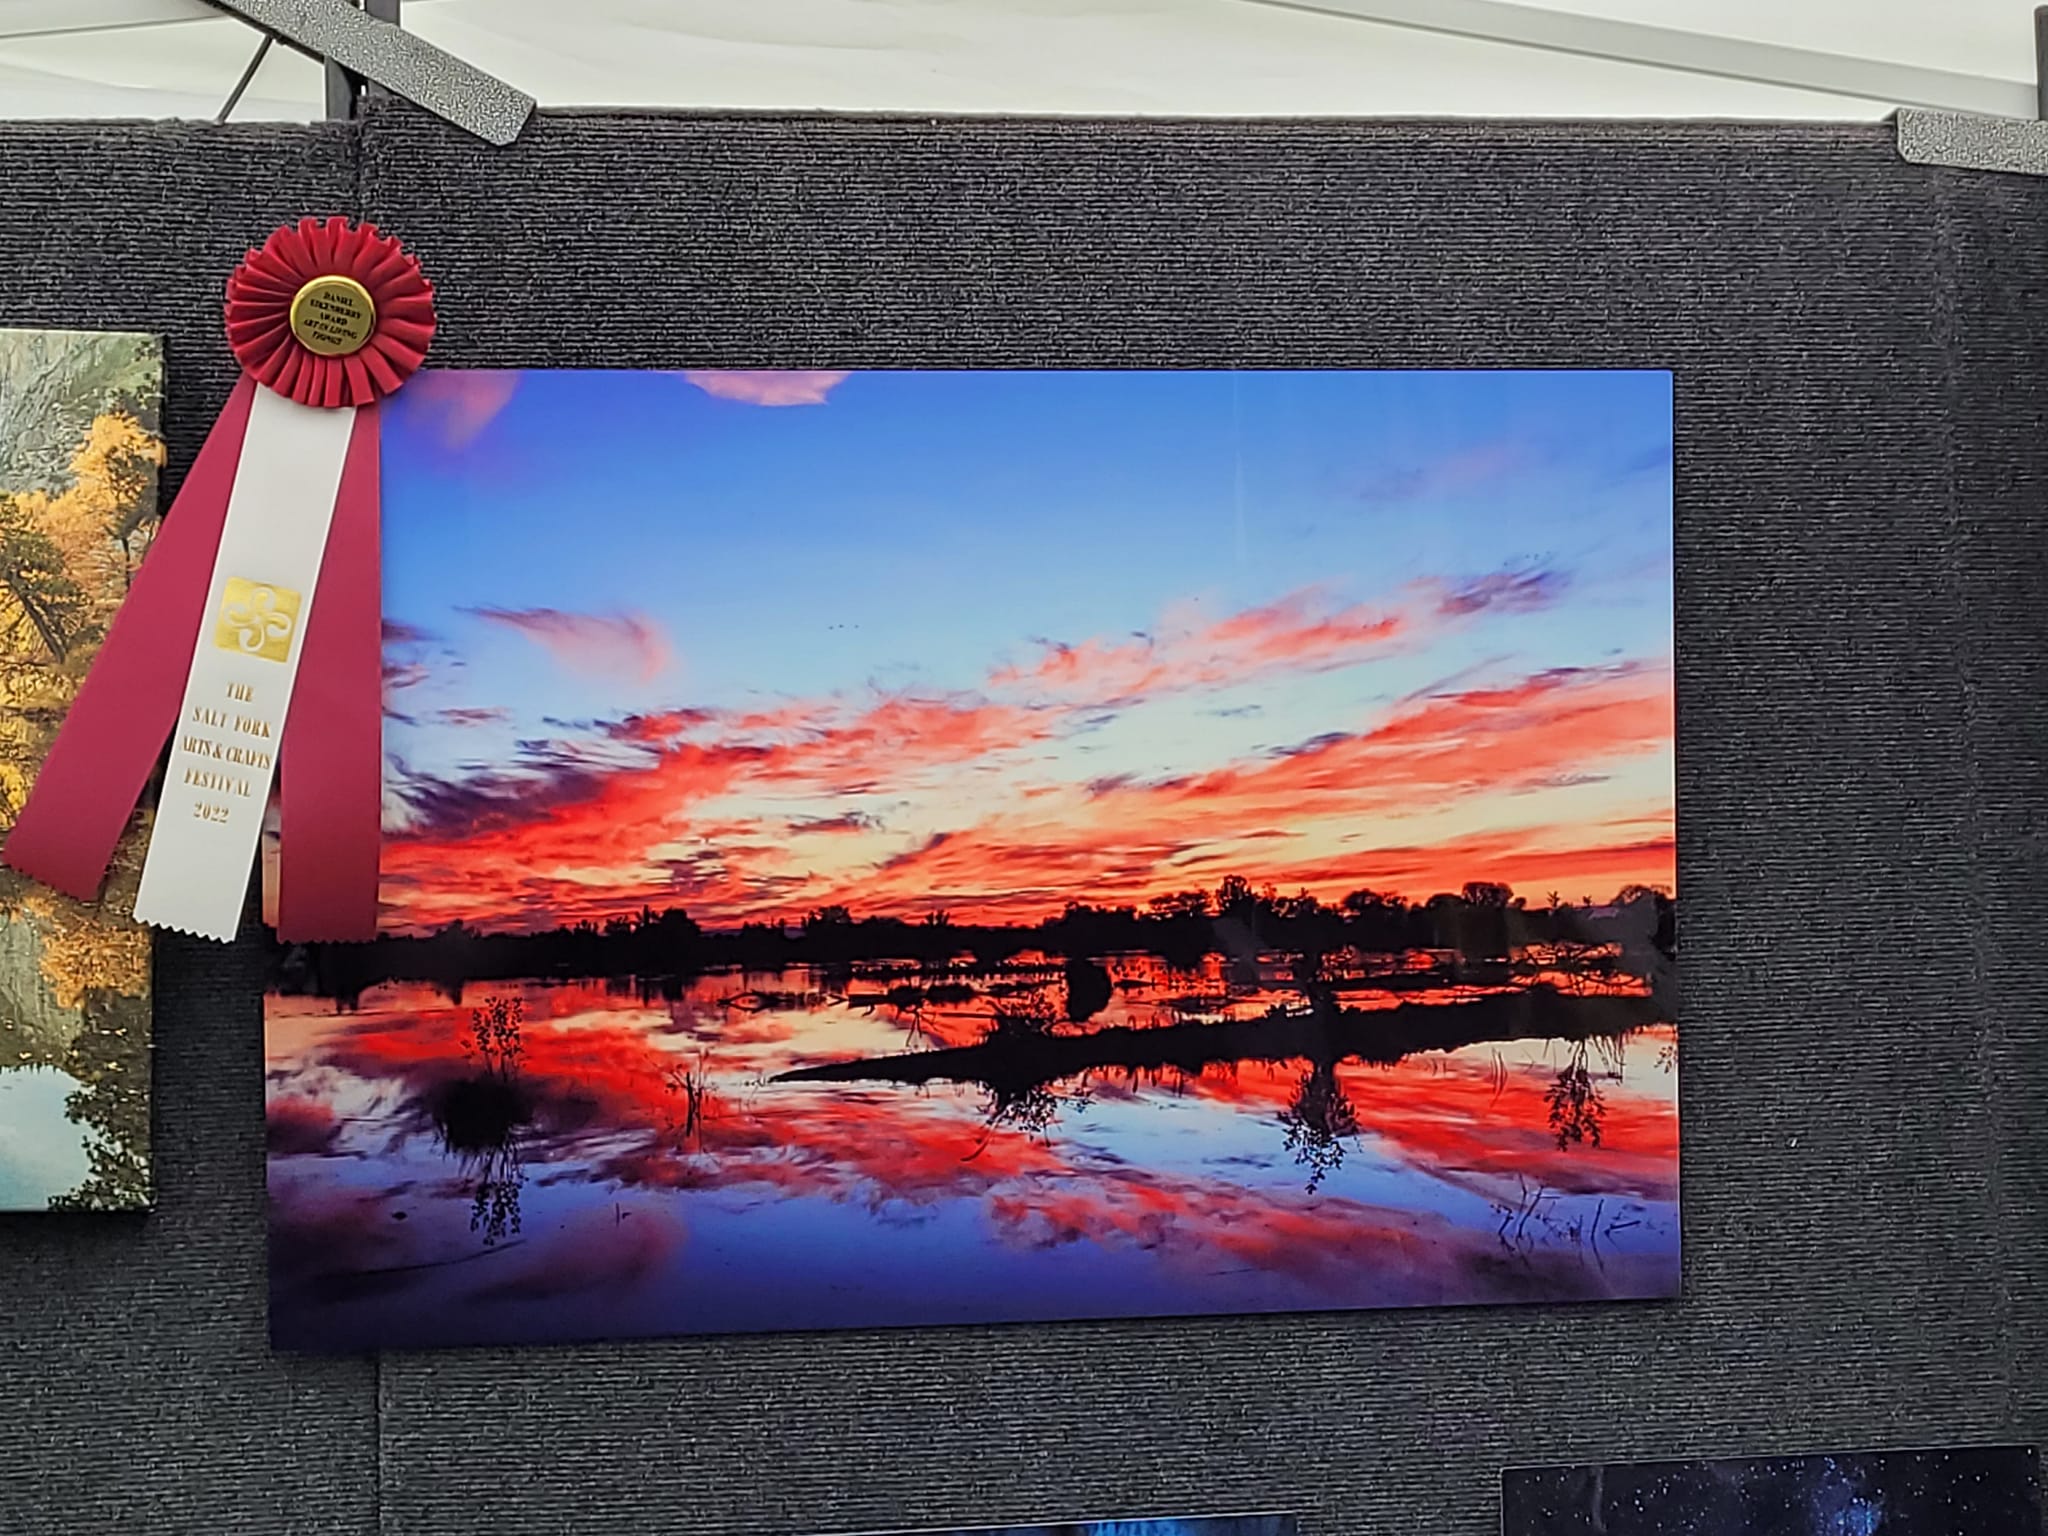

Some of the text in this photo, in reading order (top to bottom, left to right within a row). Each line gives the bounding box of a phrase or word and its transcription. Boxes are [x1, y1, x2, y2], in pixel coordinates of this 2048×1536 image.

[320, 312, 348, 325] AWARD
[226, 682, 254, 702] THE
[192, 706, 271, 738] SALT FORK
[181, 735, 272, 770] ARTS & CRAFTS
[184, 767, 251, 797] FESTIVAL
[193, 802, 229, 824] 2022
